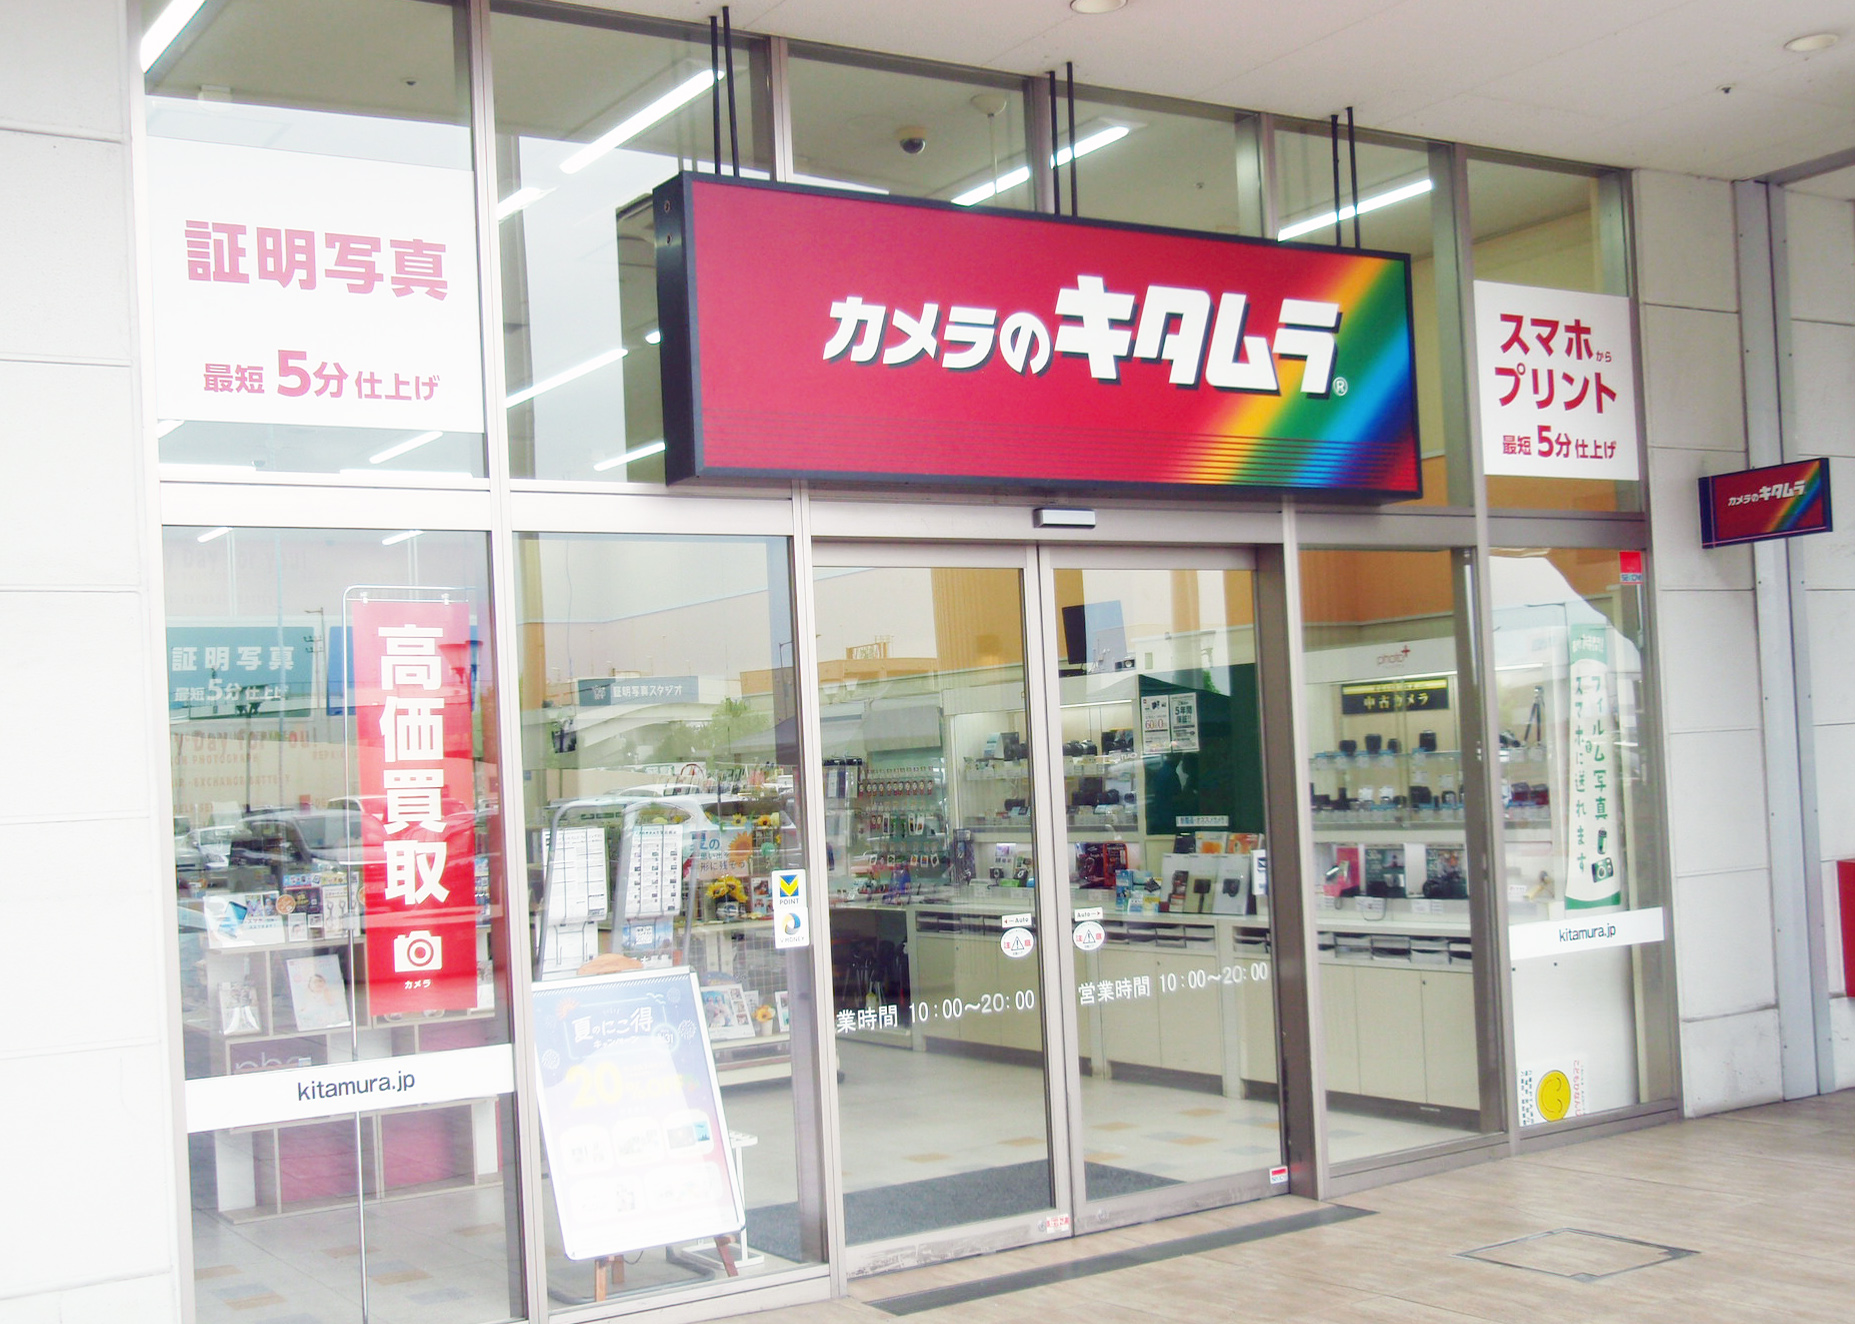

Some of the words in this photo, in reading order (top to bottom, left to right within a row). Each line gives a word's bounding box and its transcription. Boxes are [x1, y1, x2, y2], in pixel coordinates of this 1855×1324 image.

[184, 219, 448, 301] 証明写真
[823, 274, 1342, 395] カメラのキタムラ
[1500, 313, 1612, 363] スマホから
[203, 349, 440, 401] 最短5分仕上げ
[1494, 362, 1617, 414] プリント
[1502, 424, 1617, 459] 最短5分仕上げ
[1727, 480, 1806, 507] カメラのキタムラ
[172, 646, 294, 672] 証明写真
[1363, 692, 1429, 711] 中古カメラ
[378, 623, 450, 906] 高価買取
[1591, 674, 1608, 820] フィルム写真
[1573, 674, 1588, 874] スマホに送れます
[779, 898, 800, 906] POINT
[1558, 923, 1617, 943] kitamura.jp
[404, 978, 431, 990] カメラ
[1078, 974, 1151, 1006] 営業時間
[571, 1006, 654, 1044] 夏のにこ得
[297, 1071, 415, 1102] kitamura.jp
